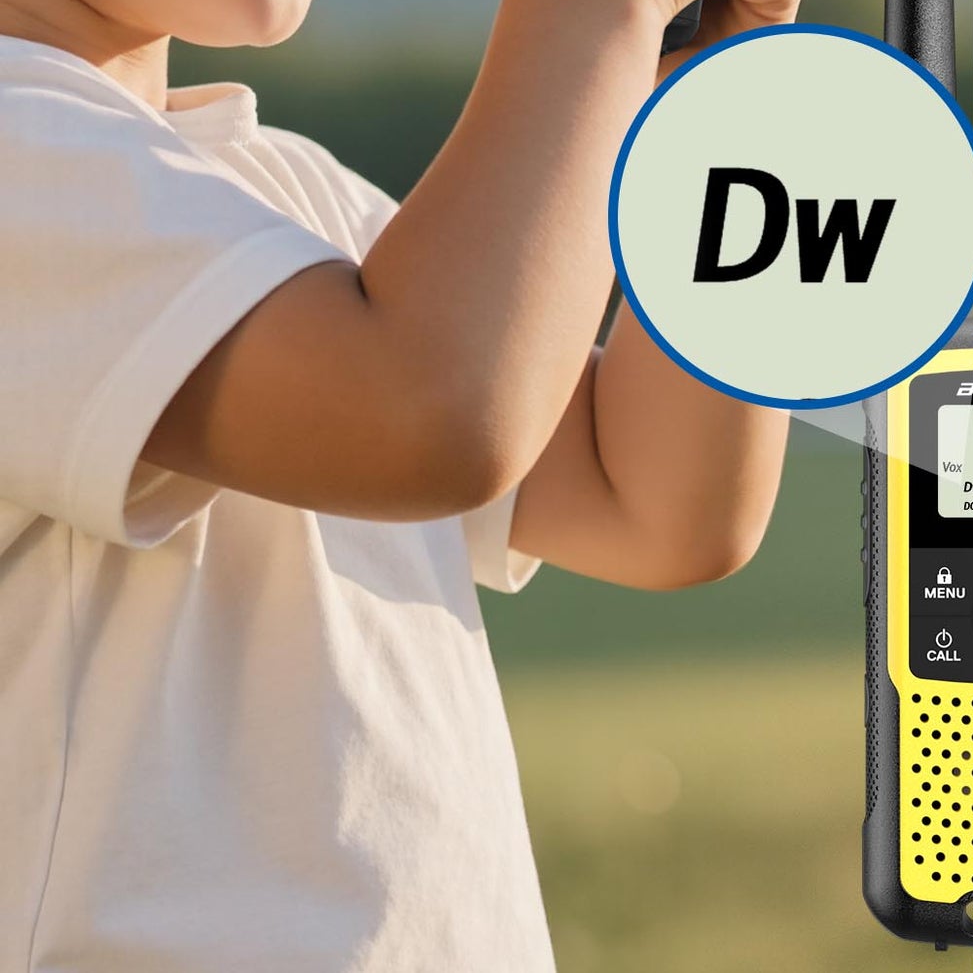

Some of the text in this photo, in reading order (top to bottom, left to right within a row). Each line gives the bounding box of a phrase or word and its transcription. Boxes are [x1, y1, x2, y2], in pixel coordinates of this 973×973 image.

[942, 461, 962, 473] Vox
[924, 588, 966, 599] MENU
[926, 650, 961, 662] CALL
